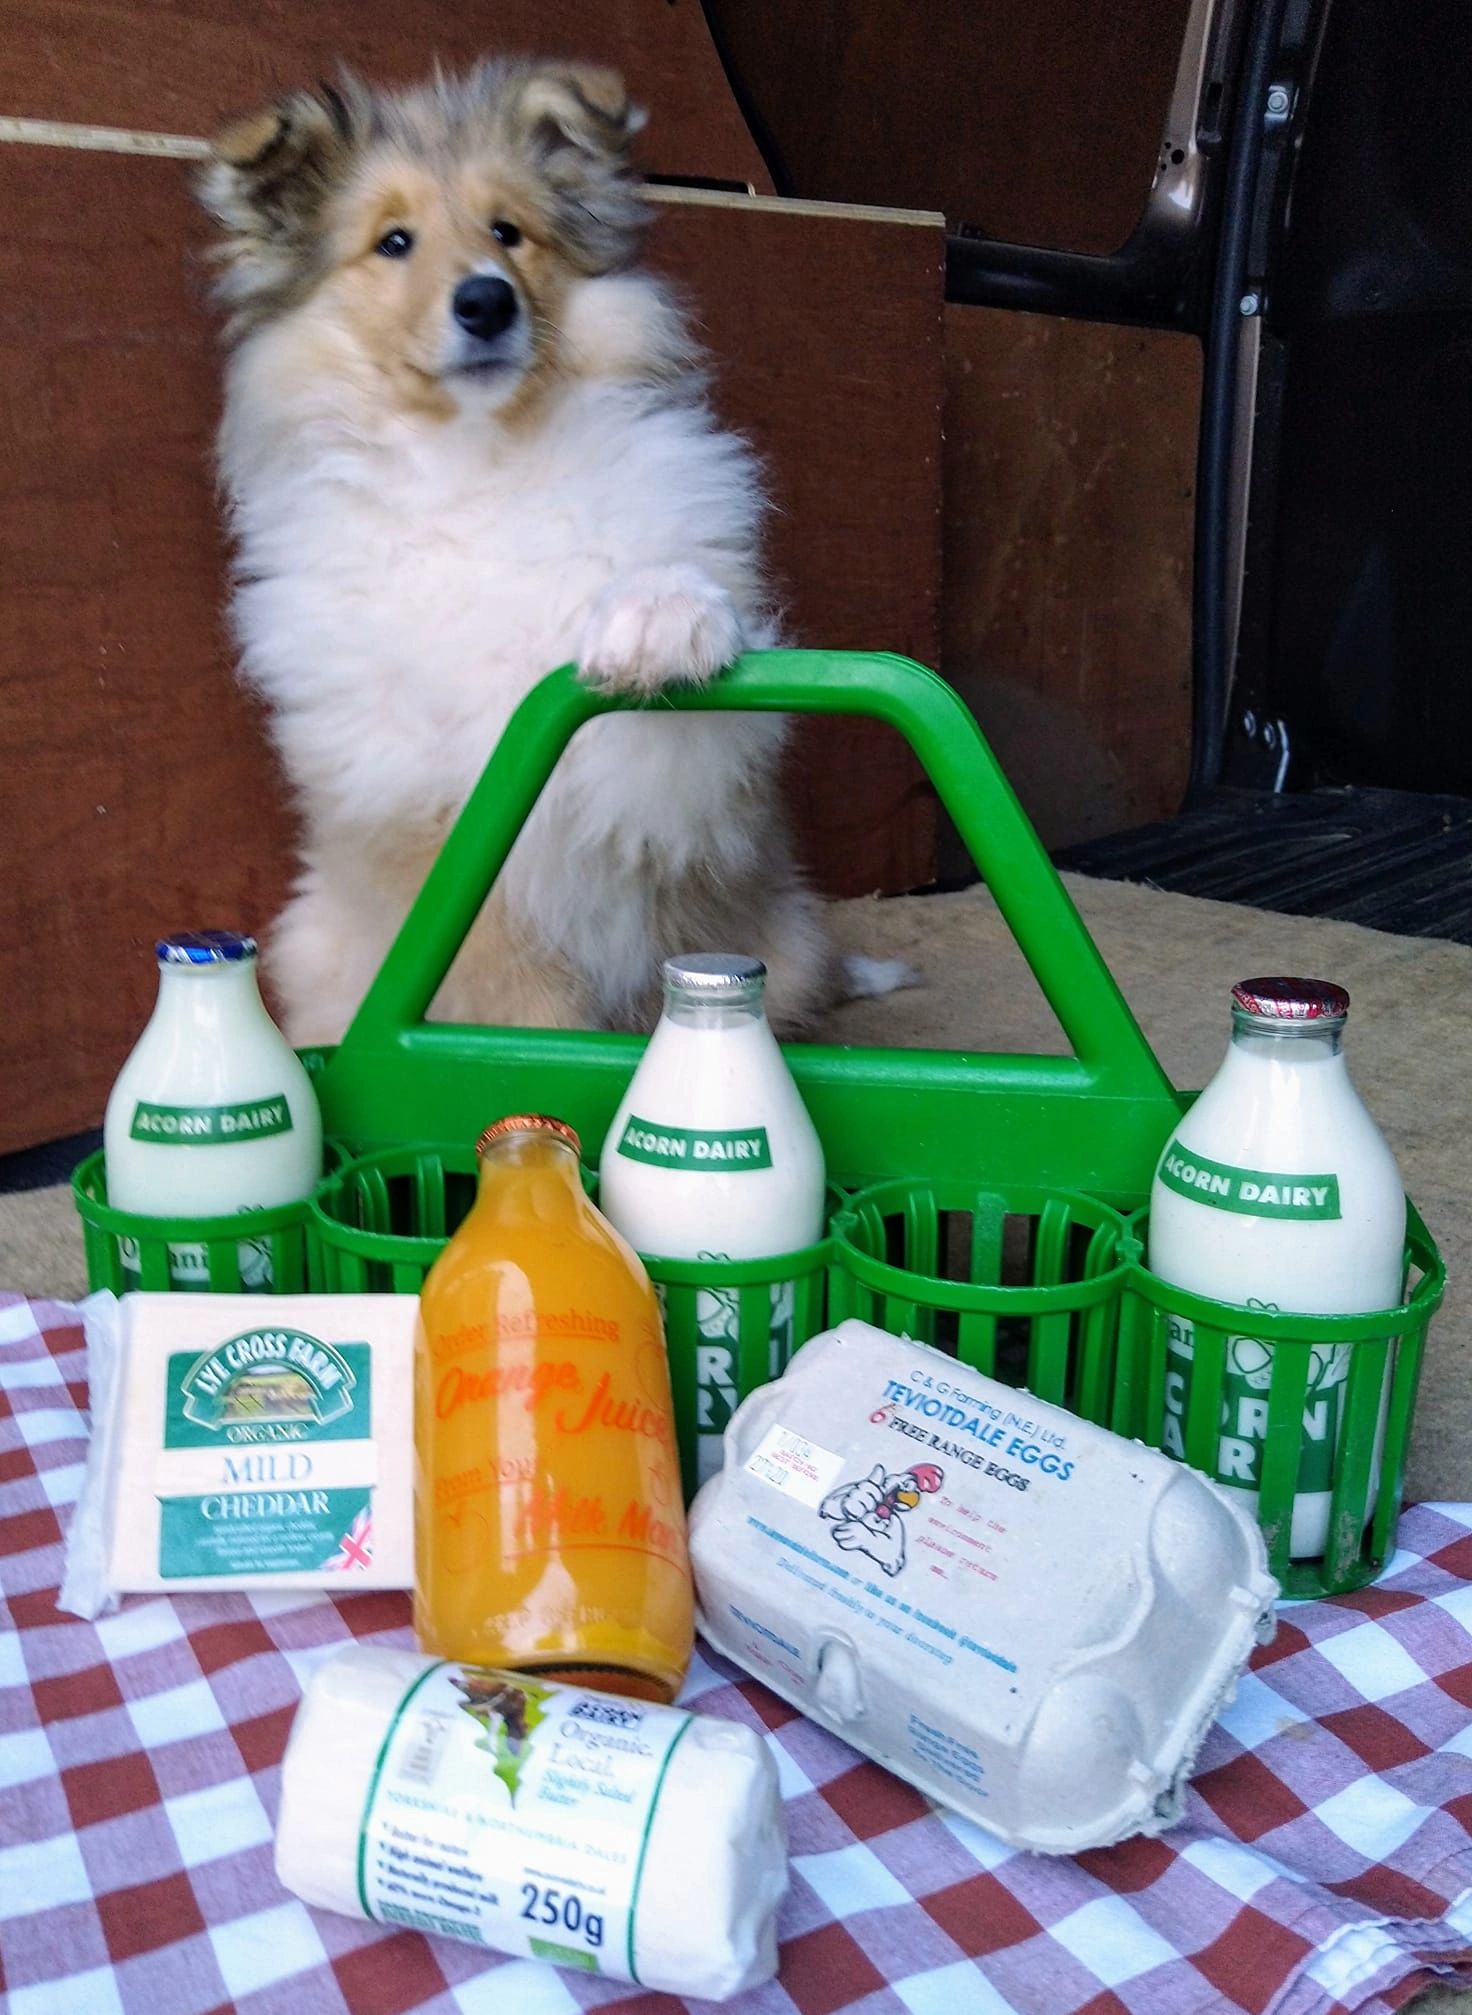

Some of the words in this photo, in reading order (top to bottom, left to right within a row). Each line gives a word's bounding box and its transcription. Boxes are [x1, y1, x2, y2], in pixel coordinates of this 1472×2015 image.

[136, 1111, 213, 1136] ACORN
[220, 1104, 283, 1133] DAIRY
[624, 1127, 687, 1159] ACORN
[693, 1138, 761, 1160] DAIRY
[1164, 1153, 1231, 1197] ACORN
[1239, 1181, 1329, 1207] DAIRY
[225, 1333, 289, 1370] CROSS
[435, 1361, 583, 1421] Orange
[554, 1370, 670, 1441] Juice
[910, 1370, 924, 1384] C
[923, 1375, 933, 1390] &
[936, 1382, 949, 1395] G
[950, 1386, 1003, 1421] Farming
[226, 1422, 311, 1444] ORGANIC
[869, 1402, 899, 1424] 6
[887, 1415, 927, 1443] FREE
[926, 1433, 986, 1471] RANGE
[983, 1459, 1032, 1492] EGGS
[882, 1379, 1007, 1448] TEVIOTDALE
[1005, 1436, 1076, 1482] EGGS
[222, 1452, 314, 1485] MILD
[201, 1491, 332, 1521] CHEDDAR
[519, 1881, 605, 1948] 250g
